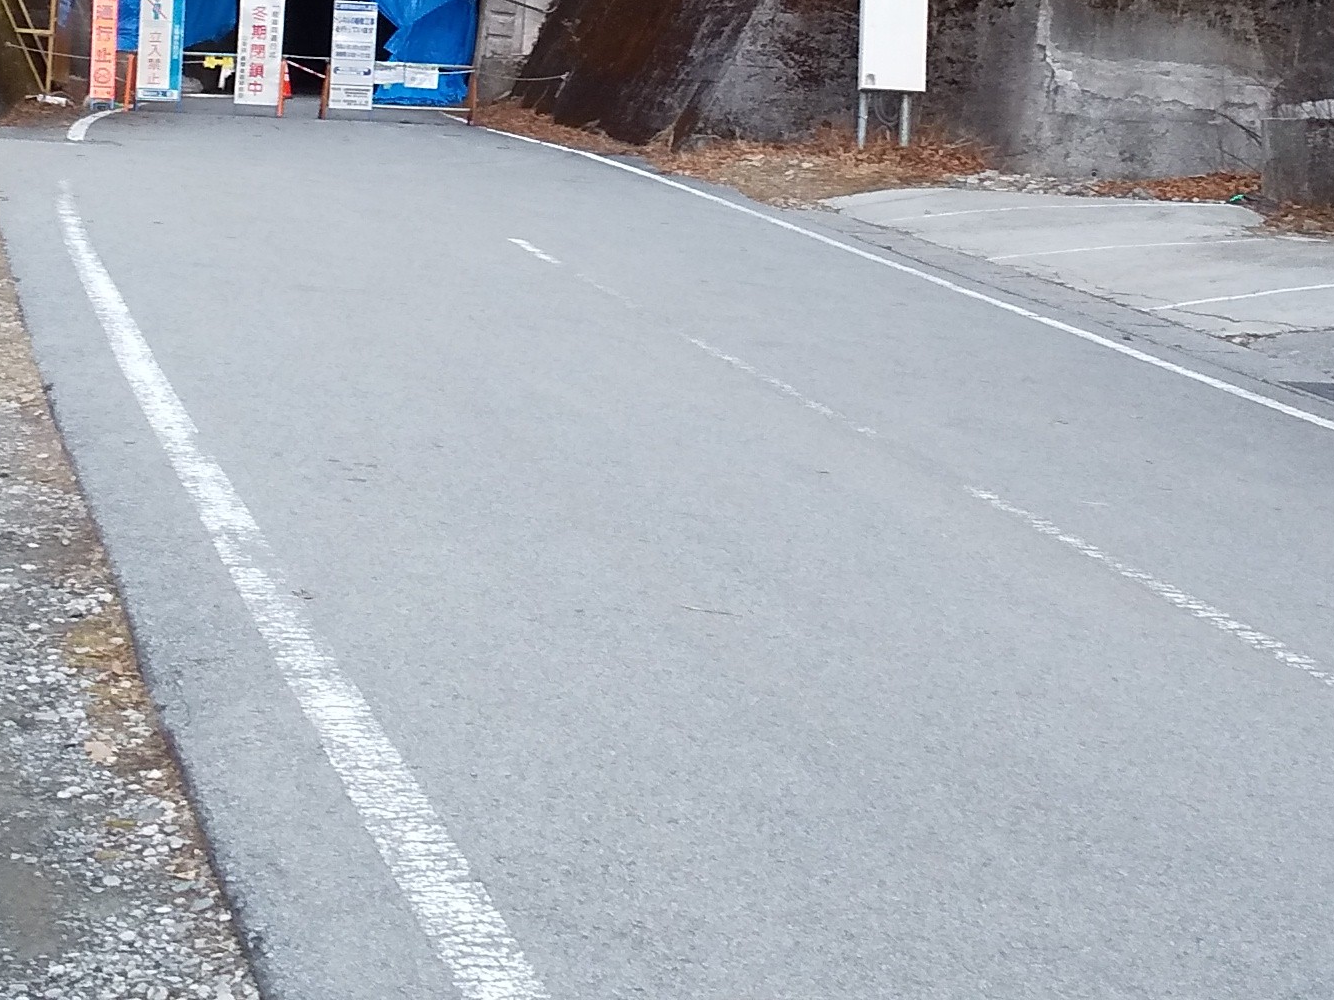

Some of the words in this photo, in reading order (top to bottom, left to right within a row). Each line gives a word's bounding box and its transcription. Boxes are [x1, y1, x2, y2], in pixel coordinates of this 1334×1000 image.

[147, 32, 163, 85] 立入禁止
[248, 5, 268, 96] 冬期閉鎖中
